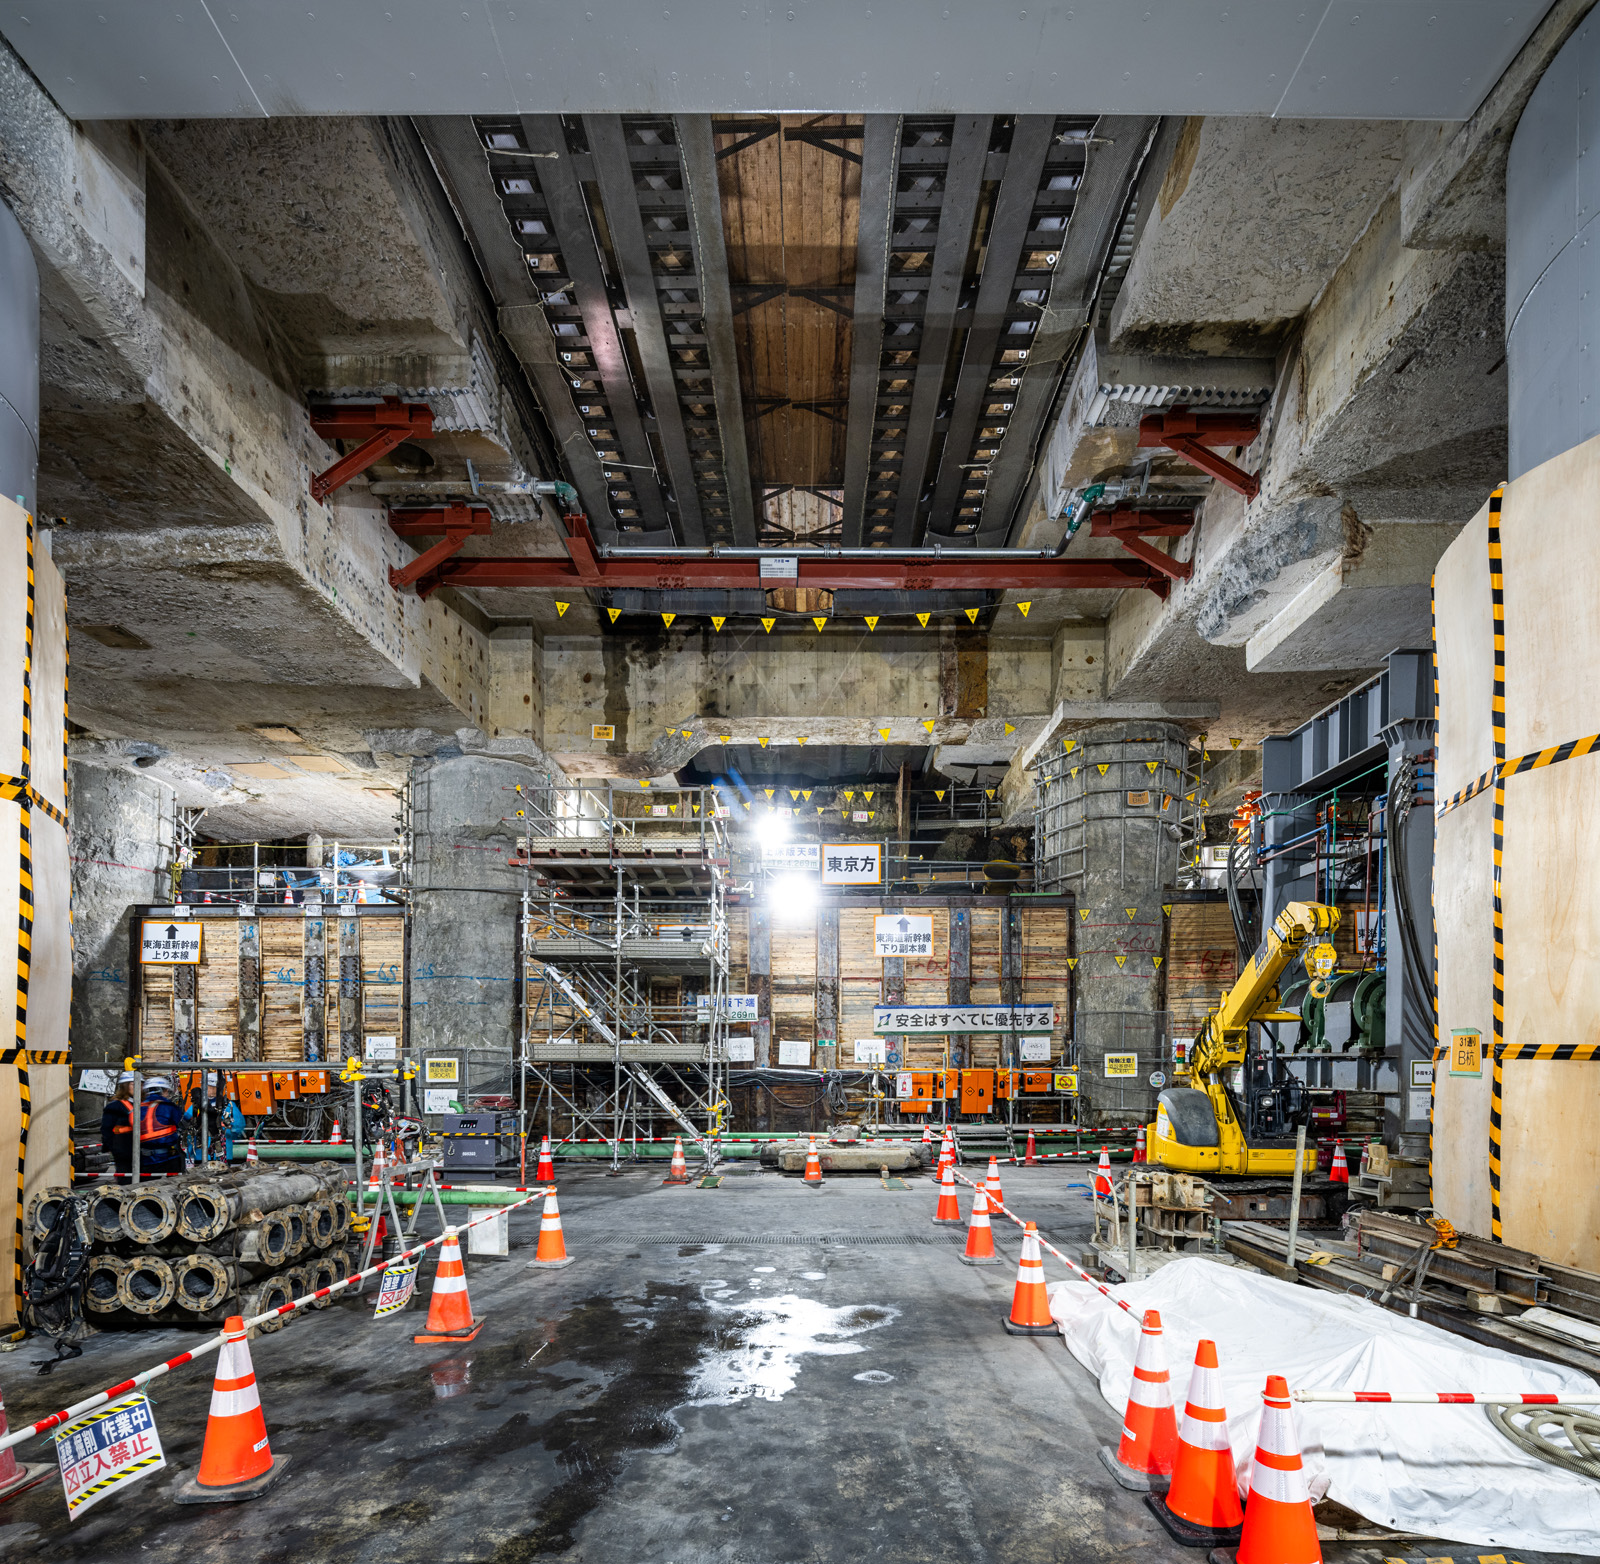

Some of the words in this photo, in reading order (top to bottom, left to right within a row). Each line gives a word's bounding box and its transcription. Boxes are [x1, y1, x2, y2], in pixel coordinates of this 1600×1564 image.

[827, 856, 876, 873] 東京方
[143, 940, 199, 950] 東海道新幹線
[876, 933, 933, 943] 東海道新幹線
[152, 950, 190, 960] 上り本線
[880, 943, 927, 954] 下り副本線
[895, 1012, 1050, 1028] 安全はすべてに優先する
[1458, 1050, 1475, 1066] B杭
[101, 1407, 148, 1445] 作業中
[78, 1433, 153, 1484] 立入禁止
